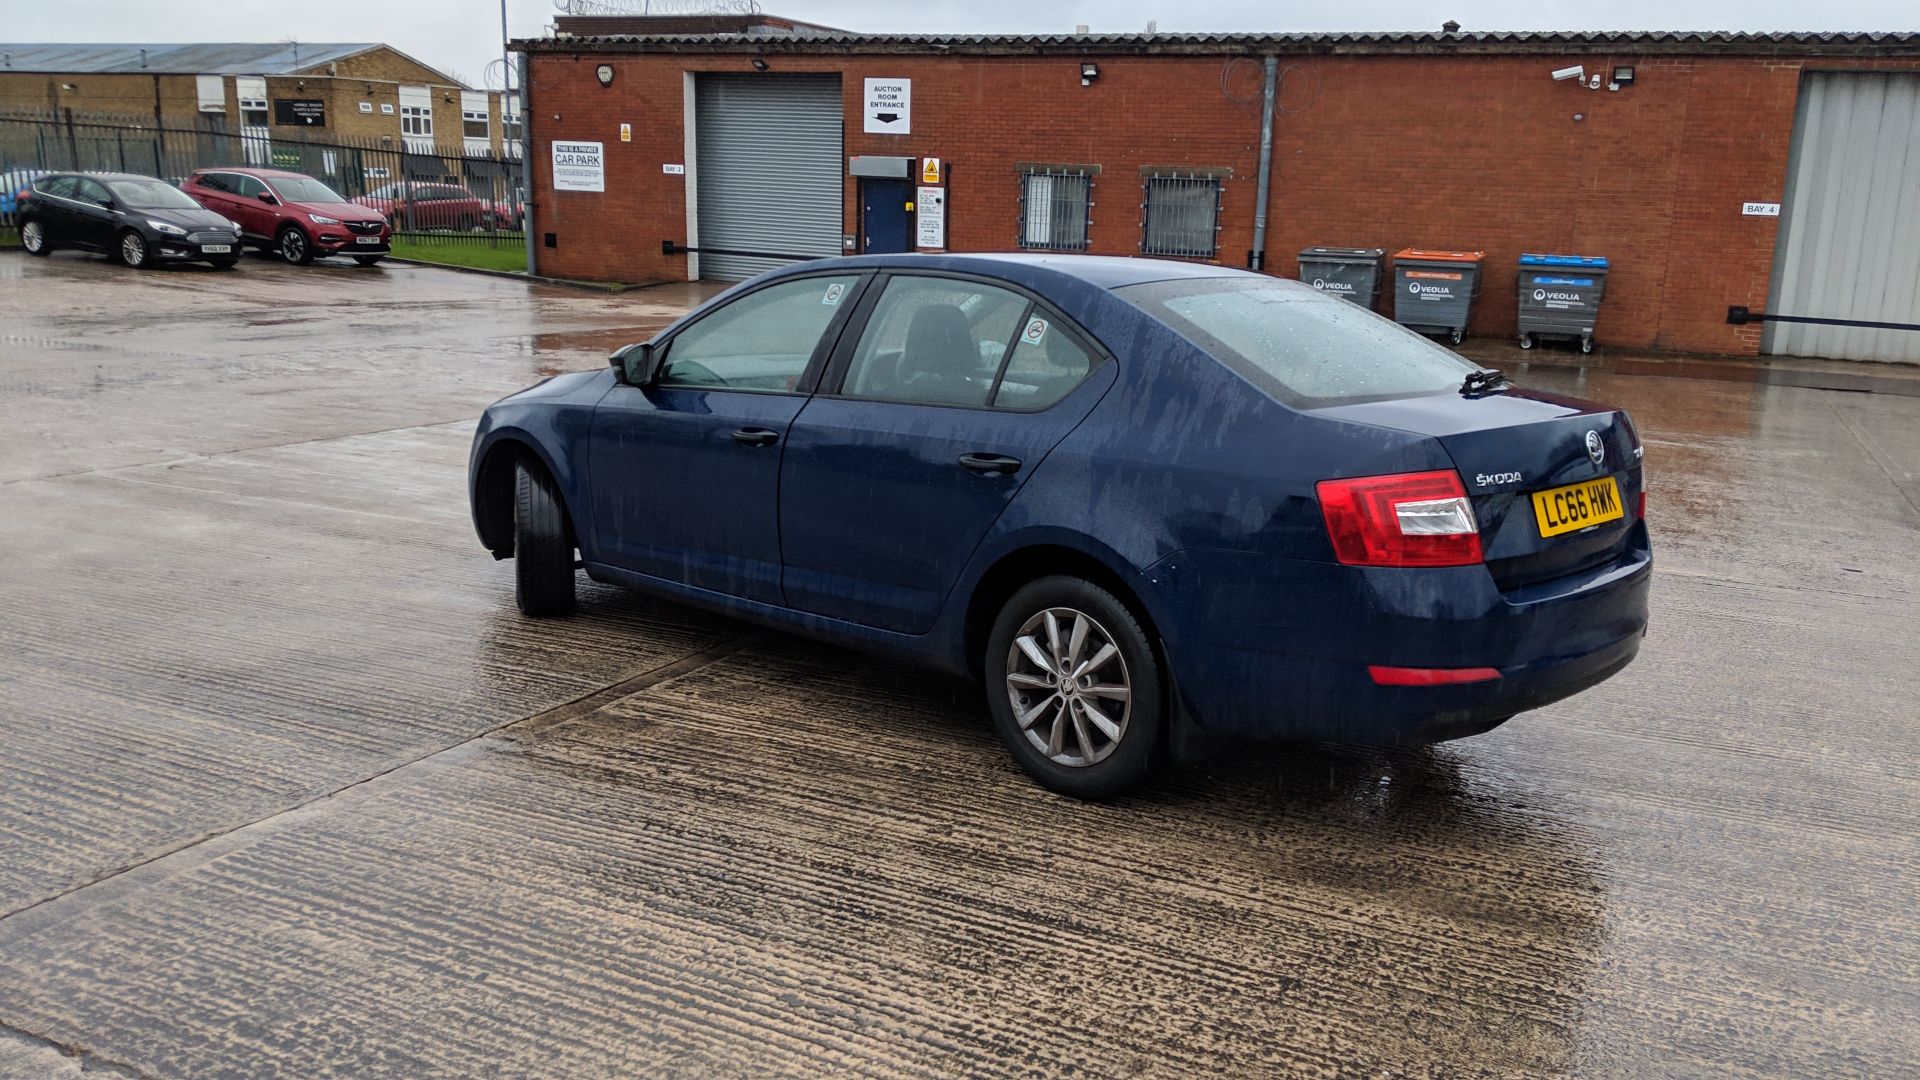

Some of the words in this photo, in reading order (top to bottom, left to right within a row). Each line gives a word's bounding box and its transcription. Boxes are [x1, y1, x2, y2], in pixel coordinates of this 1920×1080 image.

[555, 154, 574, 164] CAR
[576, 155, 600, 165] PARK
[1747, 205, 1765, 213] BAY
[1324, 282, 1352, 290] VEOLIA
[1546, 292, 1580, 300] VEOLIA
[1476, 472, 1523, 487] ŠKODA
[1542, 490, 1588, 528] LC66
[1587, 482, 1618, 517] HWK
